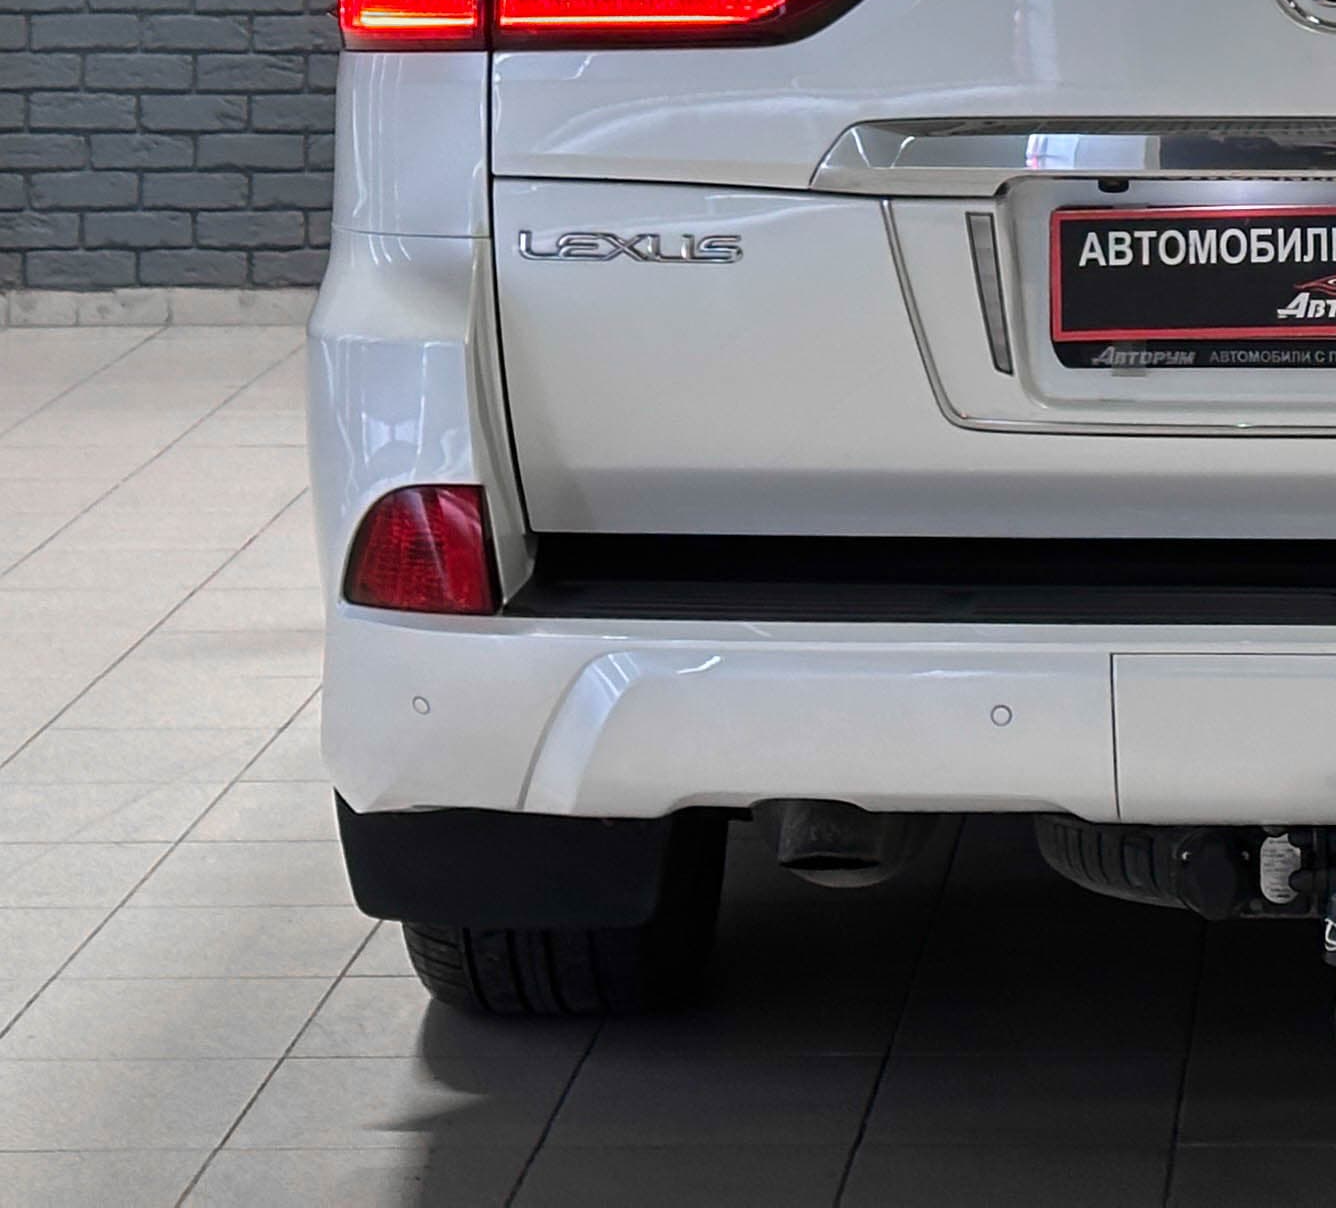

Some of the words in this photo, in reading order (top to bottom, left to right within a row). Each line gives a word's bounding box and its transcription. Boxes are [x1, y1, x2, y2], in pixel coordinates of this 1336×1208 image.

[517, 230, 744, 264] LEXUS
[1209, 350, 1313, 363] АВТОМОБИЛИ
[1314, 350, 1326, 363] С
